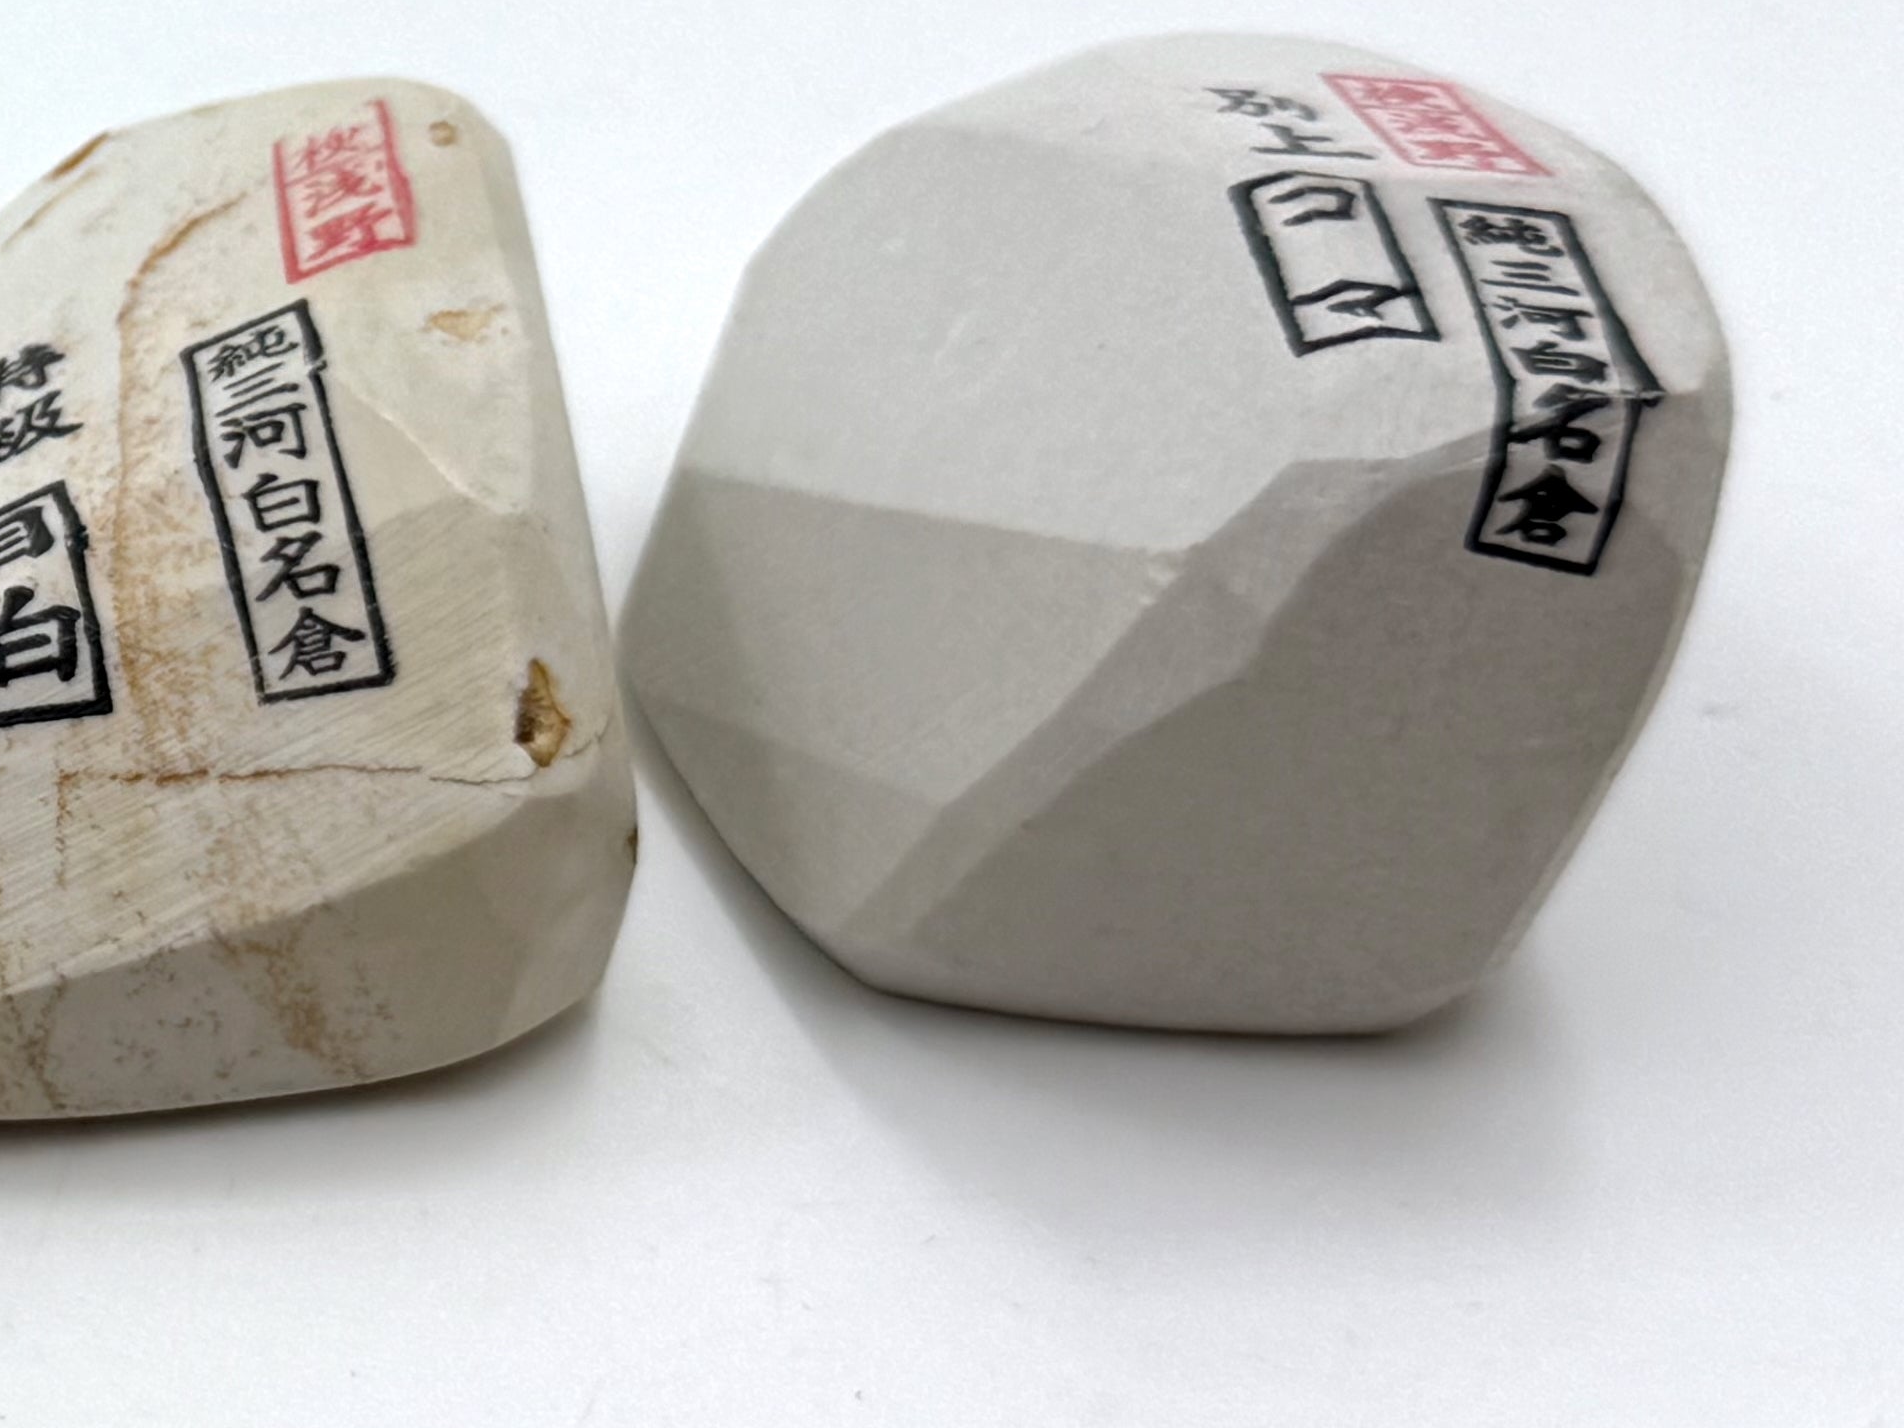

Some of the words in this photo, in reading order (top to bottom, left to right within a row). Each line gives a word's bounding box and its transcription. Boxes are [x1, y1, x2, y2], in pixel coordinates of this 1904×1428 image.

[205, 324, 365, 682] 純三河白名倉
[1457, 212, 1617, 547] 純三河白名倉
